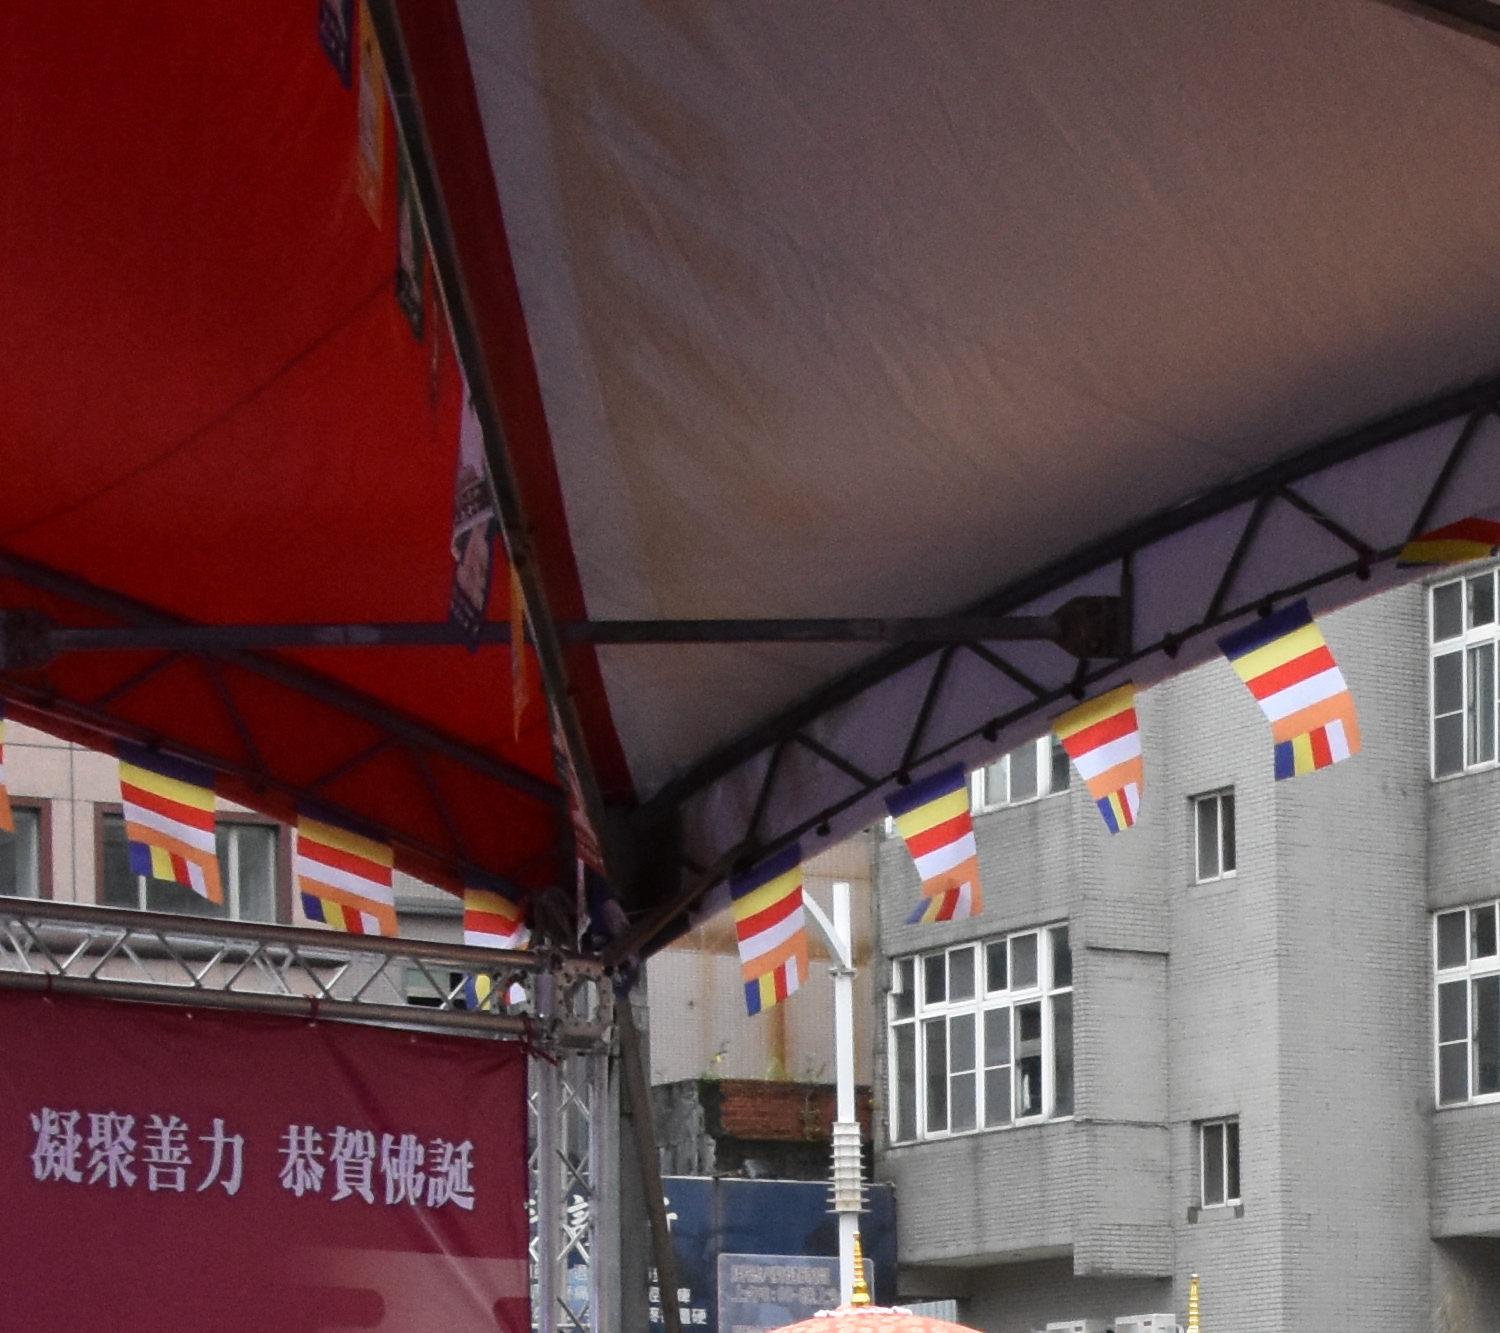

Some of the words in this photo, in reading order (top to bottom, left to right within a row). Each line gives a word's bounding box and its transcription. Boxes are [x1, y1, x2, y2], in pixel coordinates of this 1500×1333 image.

[30, 1107, 246, 1197] 凝聚善力
[278, 1124, 475, 1211] 恭賀佛誕
